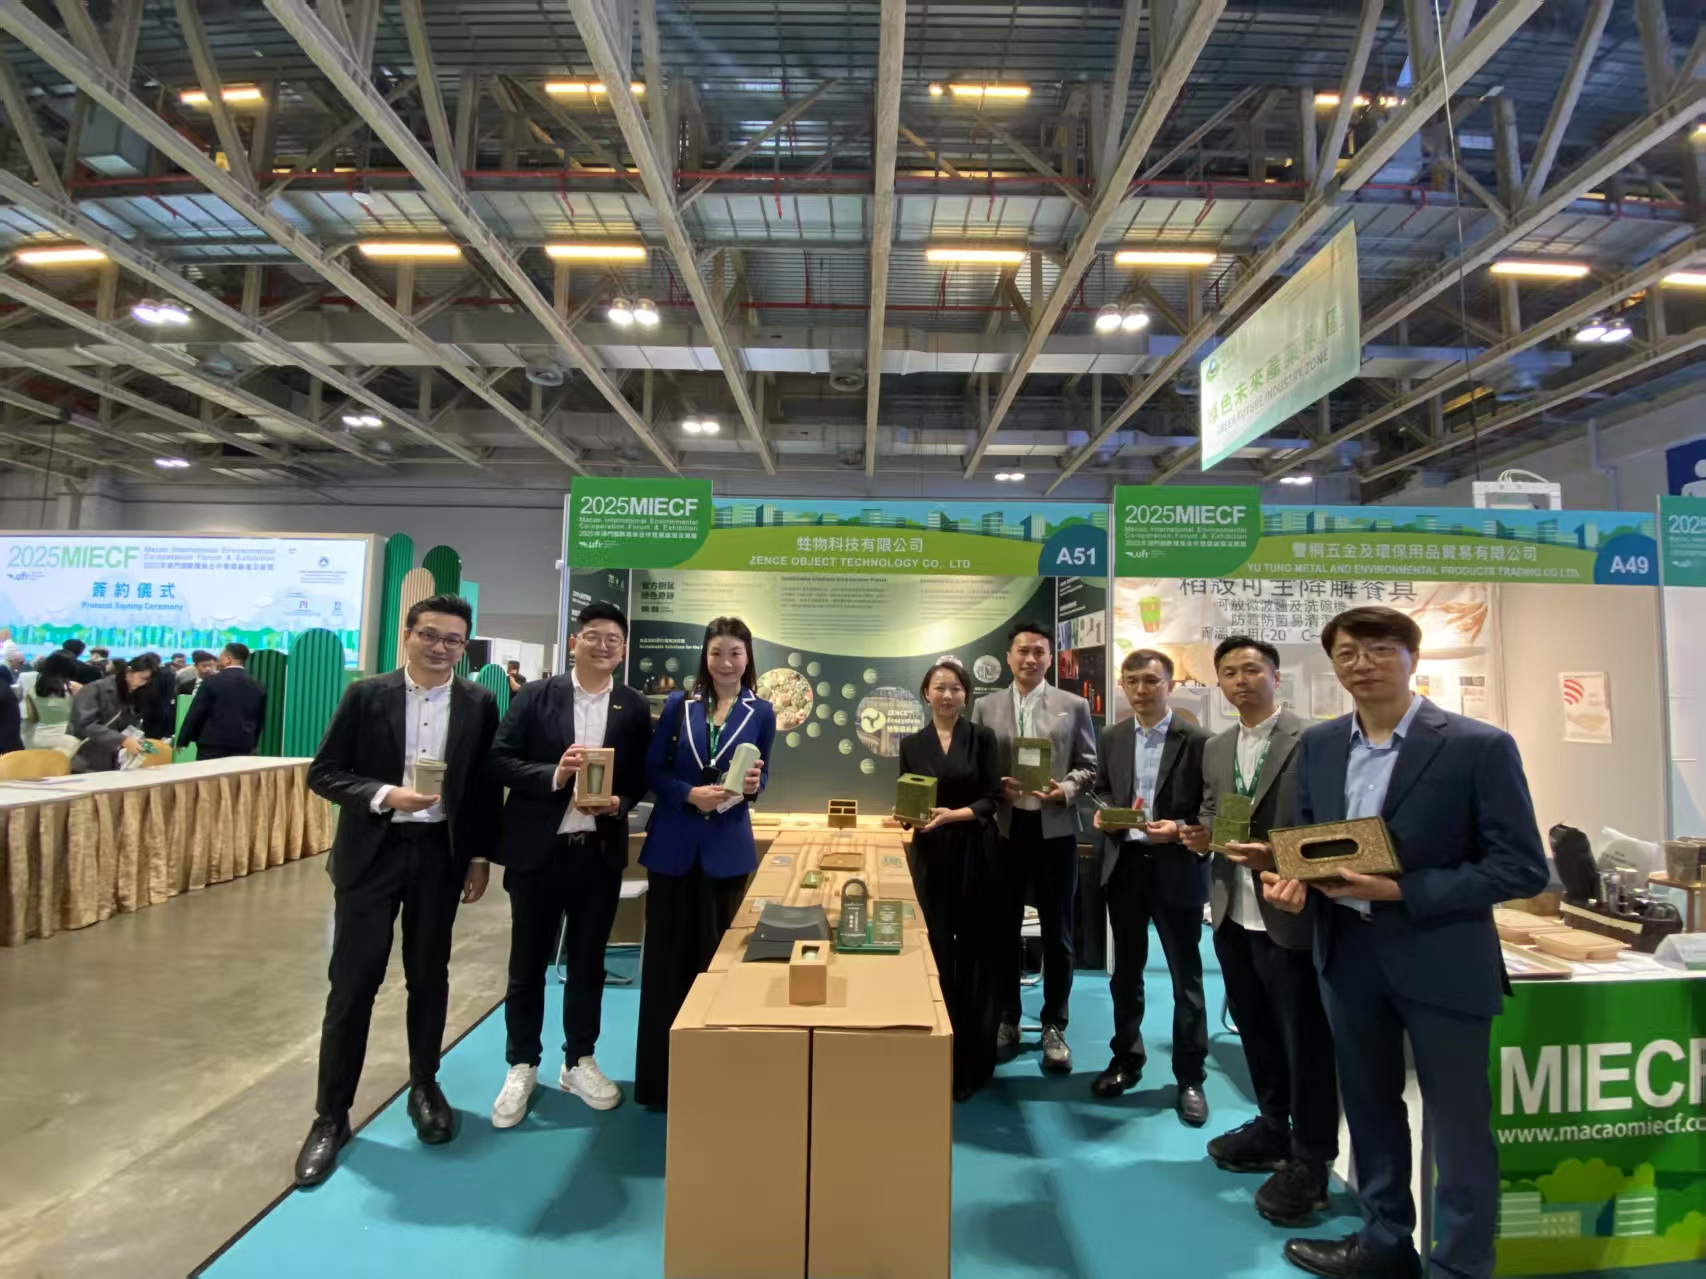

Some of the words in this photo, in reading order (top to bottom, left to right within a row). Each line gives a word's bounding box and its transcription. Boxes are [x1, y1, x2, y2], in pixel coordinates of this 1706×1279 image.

[1304, 348, 1329, 375] ZONE
[580, 496, 699, 516] 2025MIECF
[1124, 504, 1247, 524] 2025MIECF
[7, 545, 140, 569] 2025MIECF
[791, 557, 835, 567] OBJECT
[841, 557, 919, 569] TECHNOLOGY
[1055, 547, 1096, 566] A51
[1609, 555, 1650, 574] A49
[1248, 563, 1261, 573] YU
[1264, 563, 1292, 573] TUNG
[1295, 563, 1329, 574] METAL
[1330, 564, 1351, 574] AND
[1354, 564, 1439, 575] ENVIRONMENTAL
[92, 581, 176, 598] 簽約儀式
